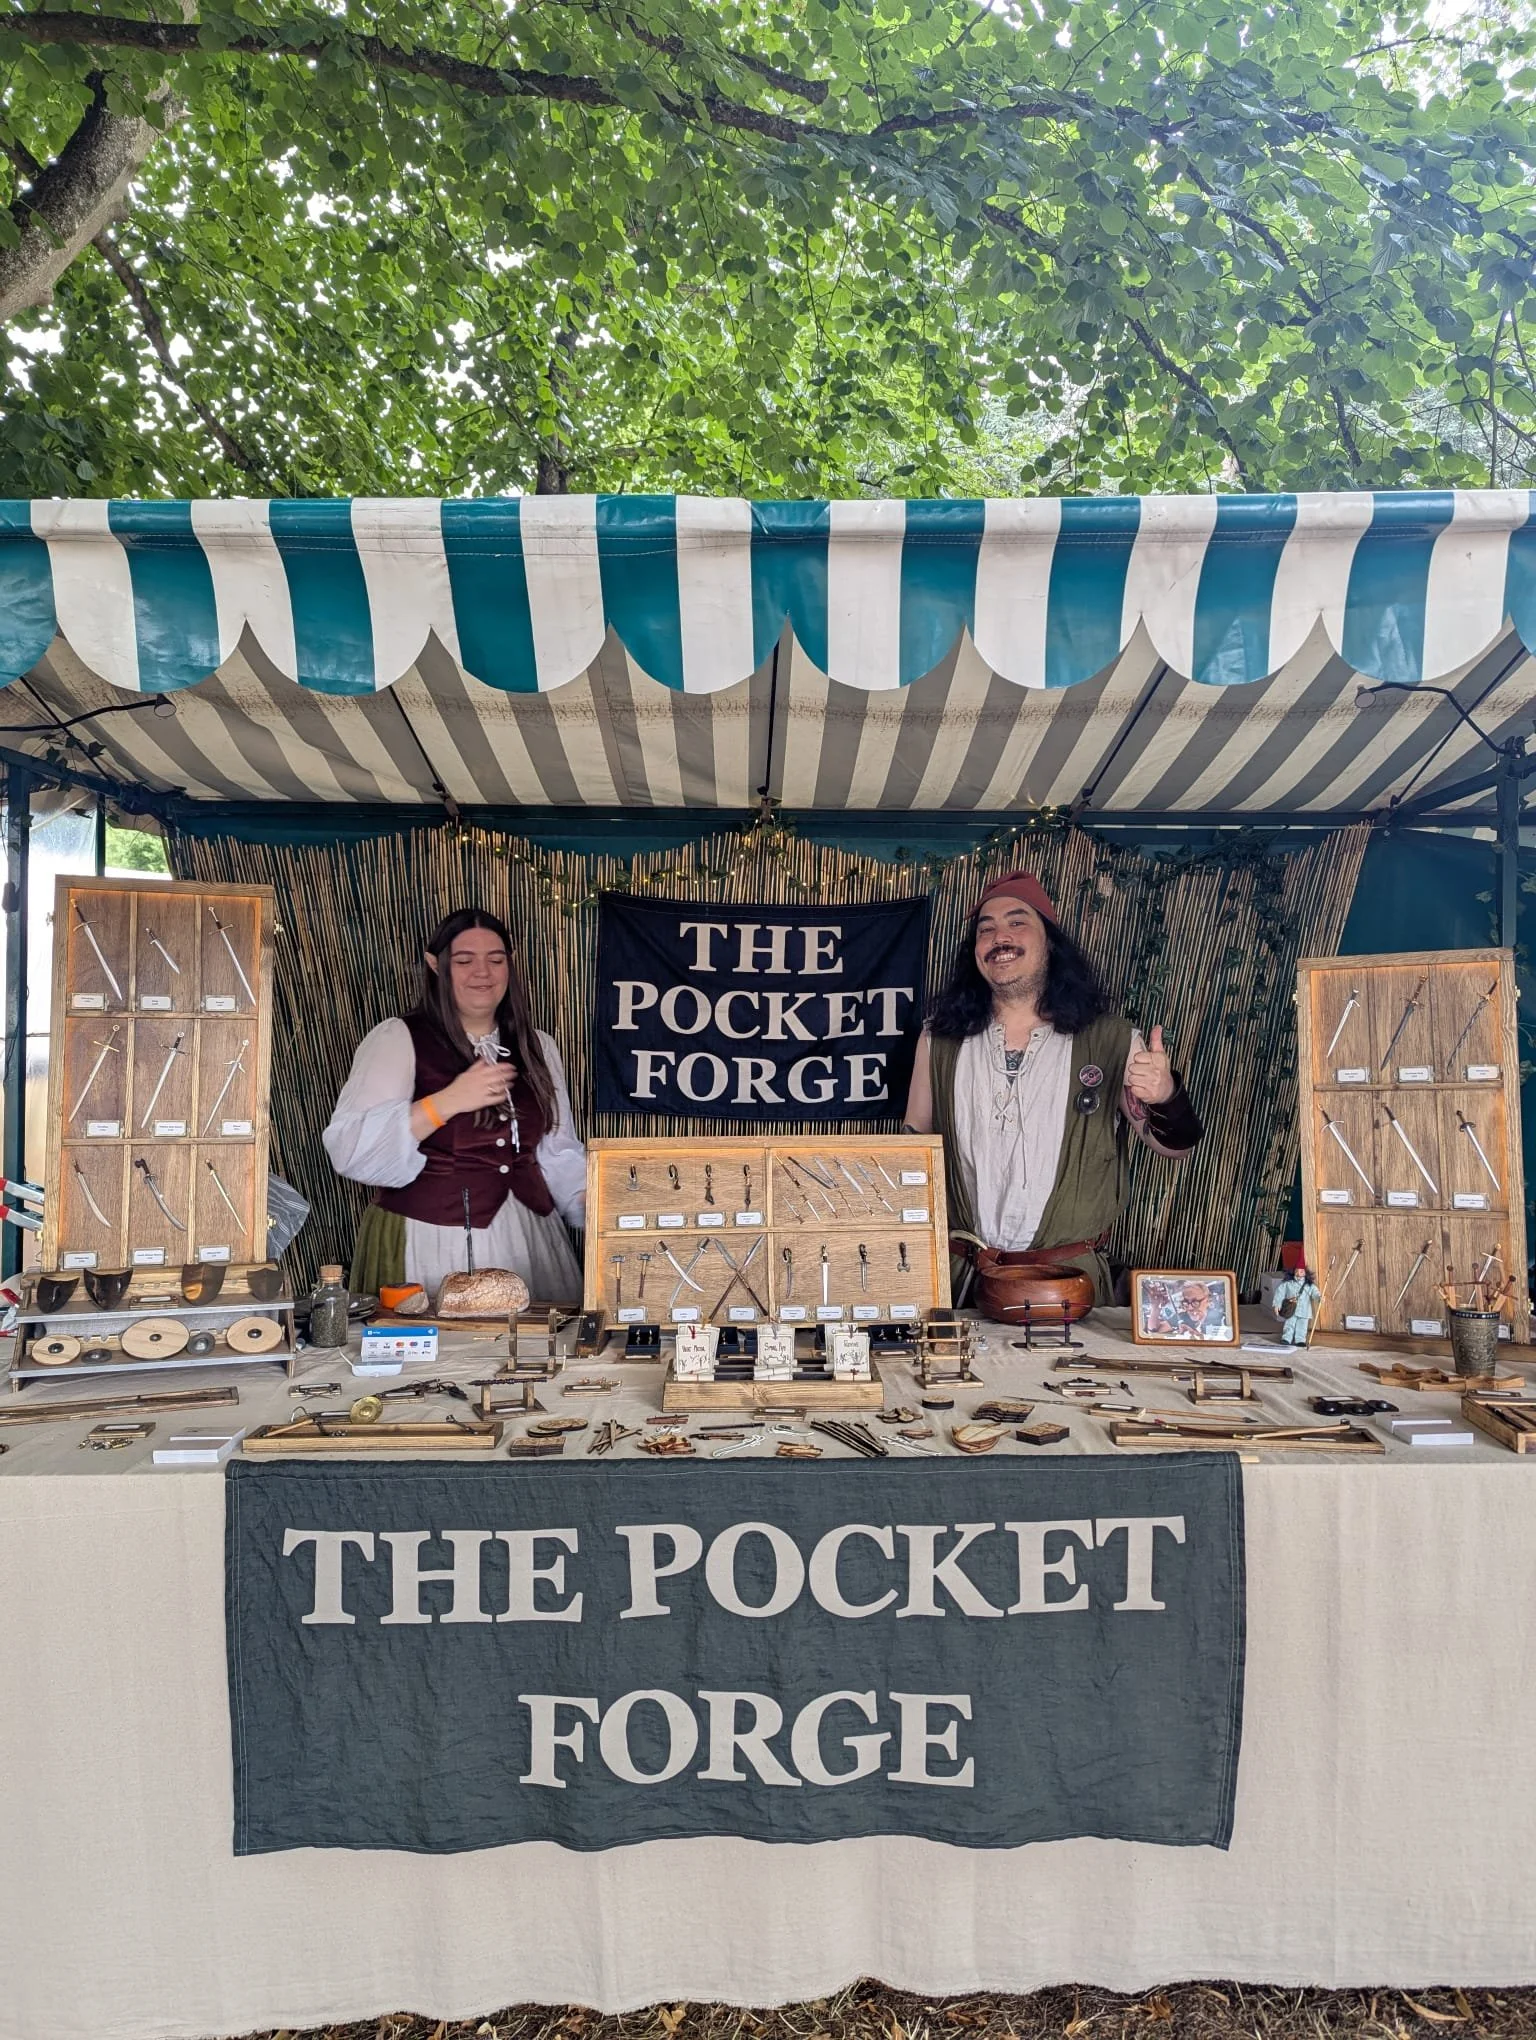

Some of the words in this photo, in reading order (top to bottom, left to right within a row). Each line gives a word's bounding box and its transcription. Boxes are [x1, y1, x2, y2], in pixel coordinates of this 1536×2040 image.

[679, 921, 843, 975] THE
[611, 980, 914, 1041] POCKET
[629, 1049, 889, 1104] FORGE
[282, 1528, 584, 1625] THE
[615, 1515, 1187, 1619] POCKET
[518, 1689, 976, 1789] FORGE
